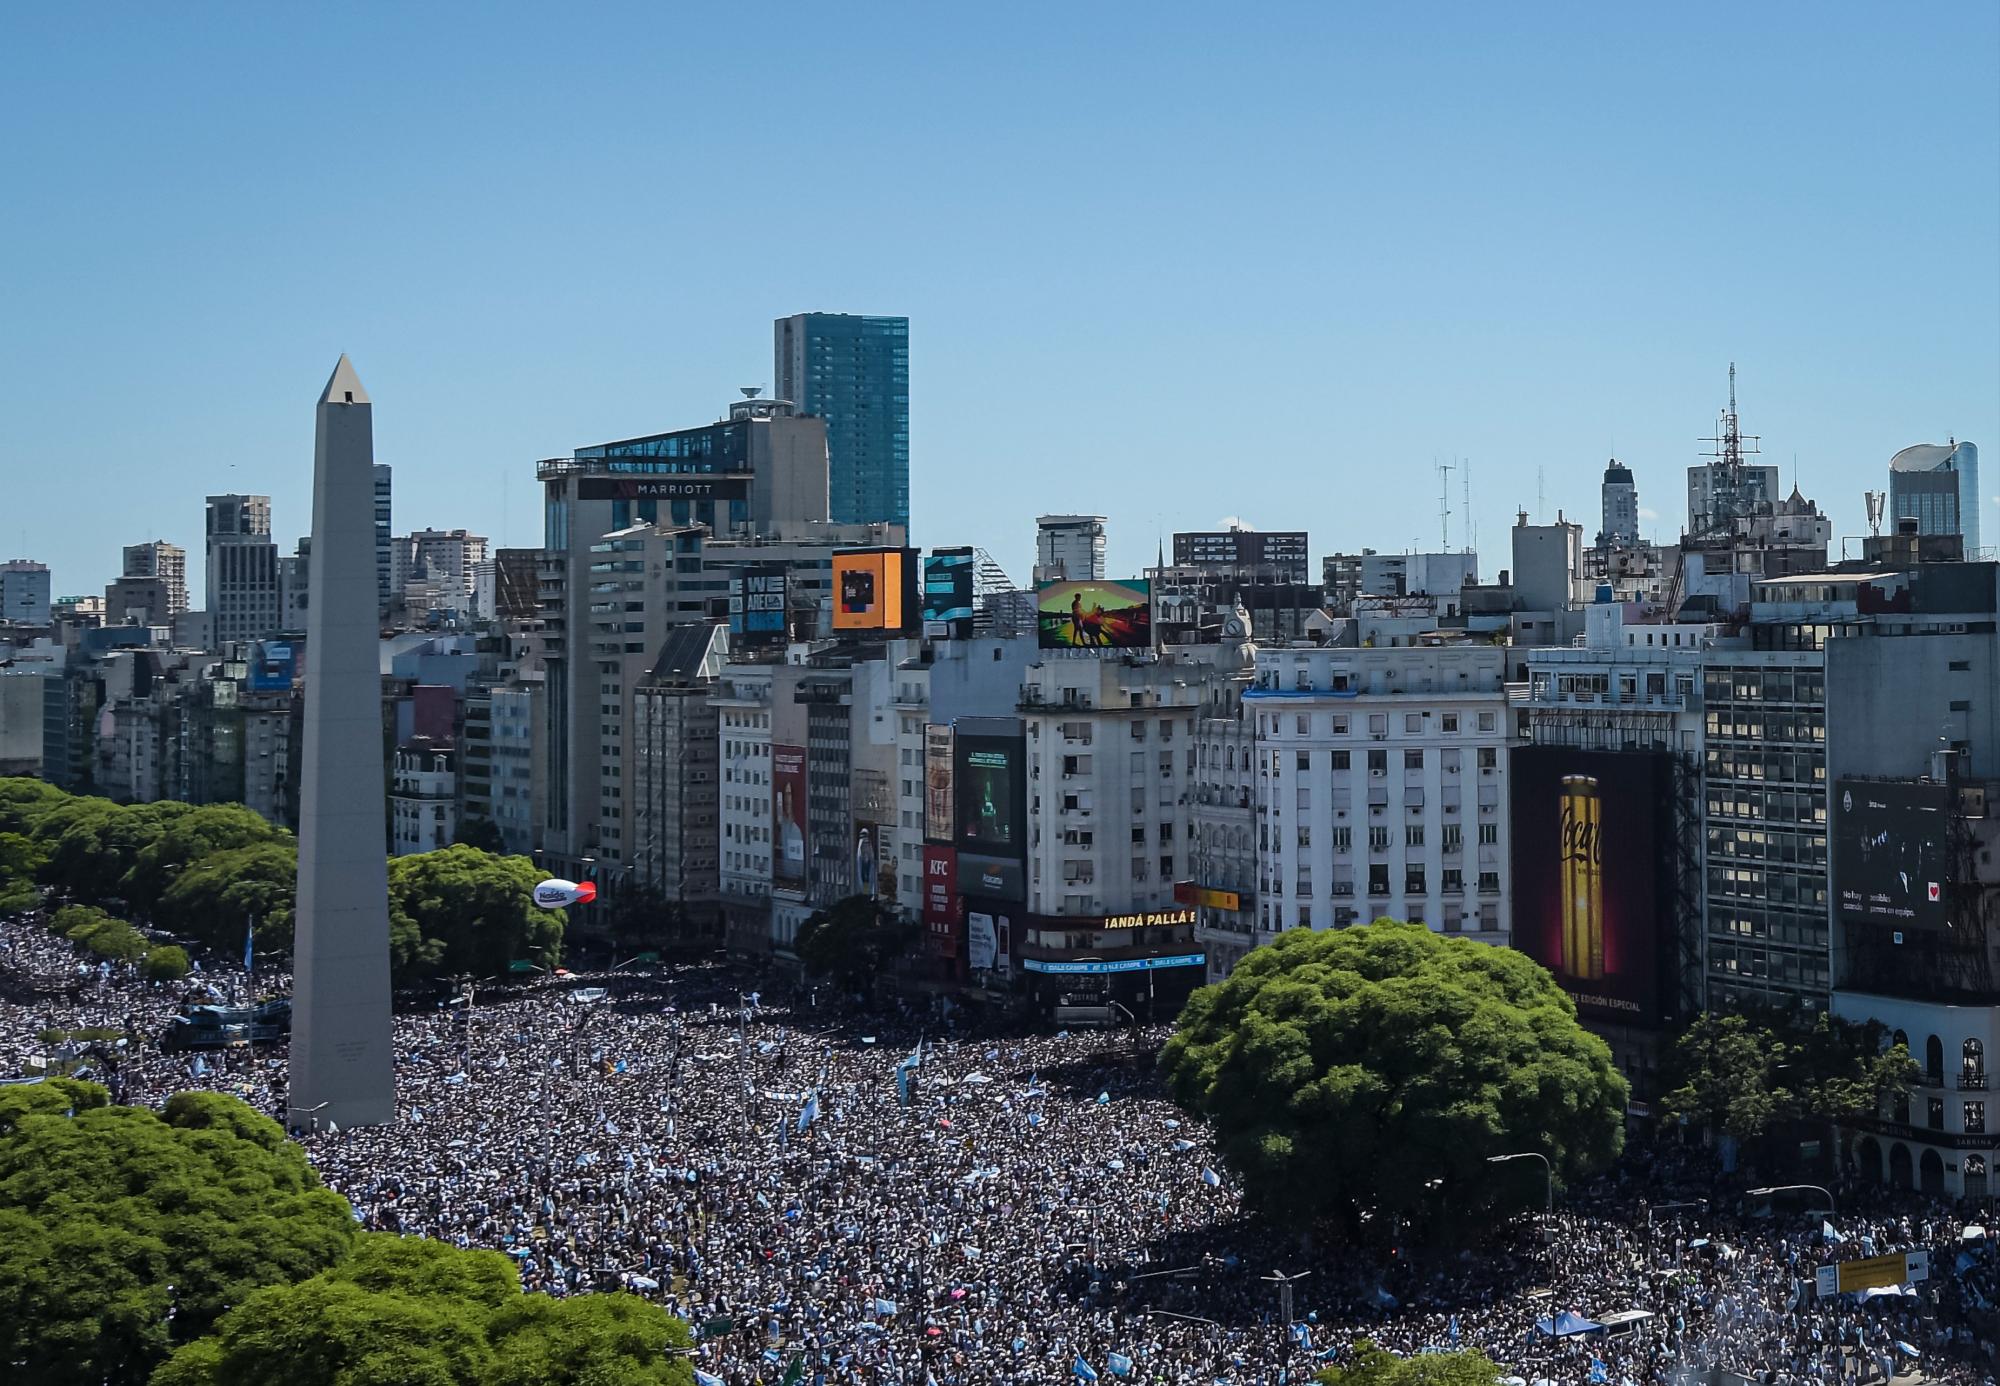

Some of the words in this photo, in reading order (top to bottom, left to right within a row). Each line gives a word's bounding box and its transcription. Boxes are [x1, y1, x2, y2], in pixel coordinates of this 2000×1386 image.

[637, 484, 712, 494] MARRIOTT
[747, 576, 785, 593] WE
[747, 594, 766, 610] ARE
[929, 859, 949, 876] KFC
[1104, 913, 1144, 929] ¡ANDÁ
[1146, 910, 1187, 926] PALLÁ
[1581, 994, 1608, 1006] EDICIÓN
[1609, 998, 1640, 1012] ESPECIAL
[1956, 1138, 1992, 1146] SABRINA
